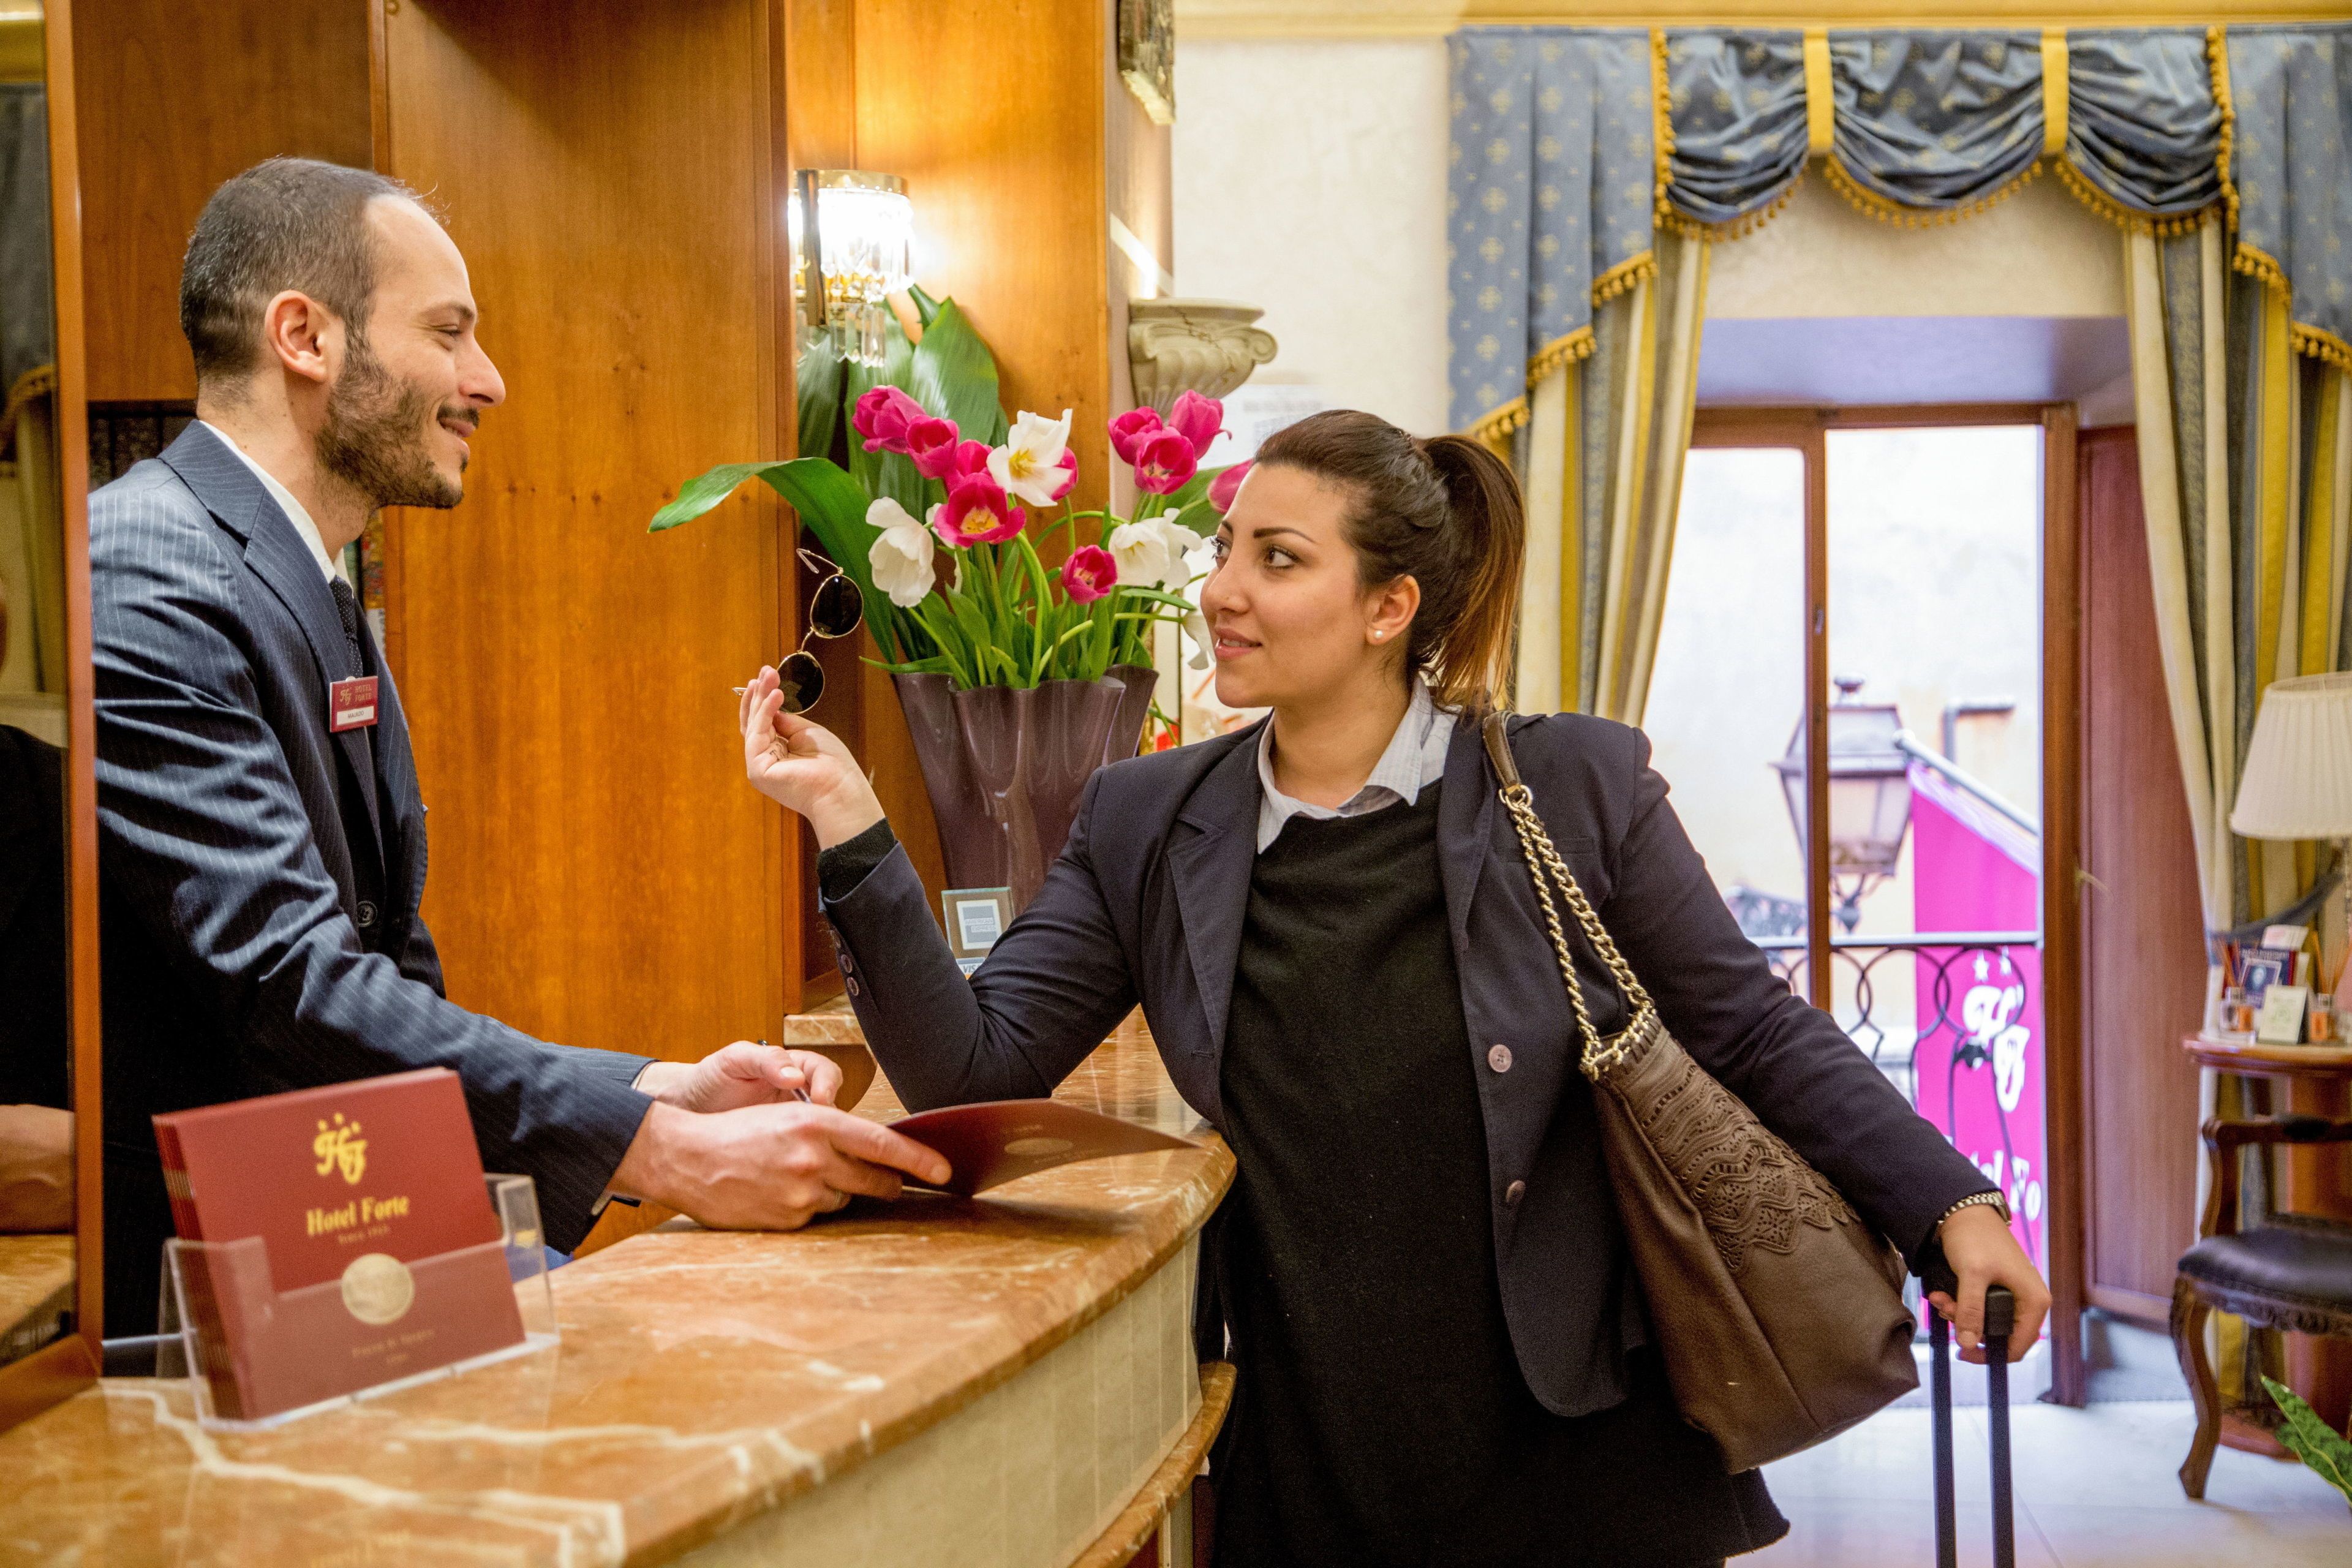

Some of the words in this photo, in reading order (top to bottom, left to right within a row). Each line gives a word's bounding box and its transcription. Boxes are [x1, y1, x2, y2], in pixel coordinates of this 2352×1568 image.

[355, 684, 372, 693] HOTEL
[355, 693, 372, 702] FORTE
[307, 1202, 357, 1237] Hotel
[361, 1196, 410, 1224] Forte
